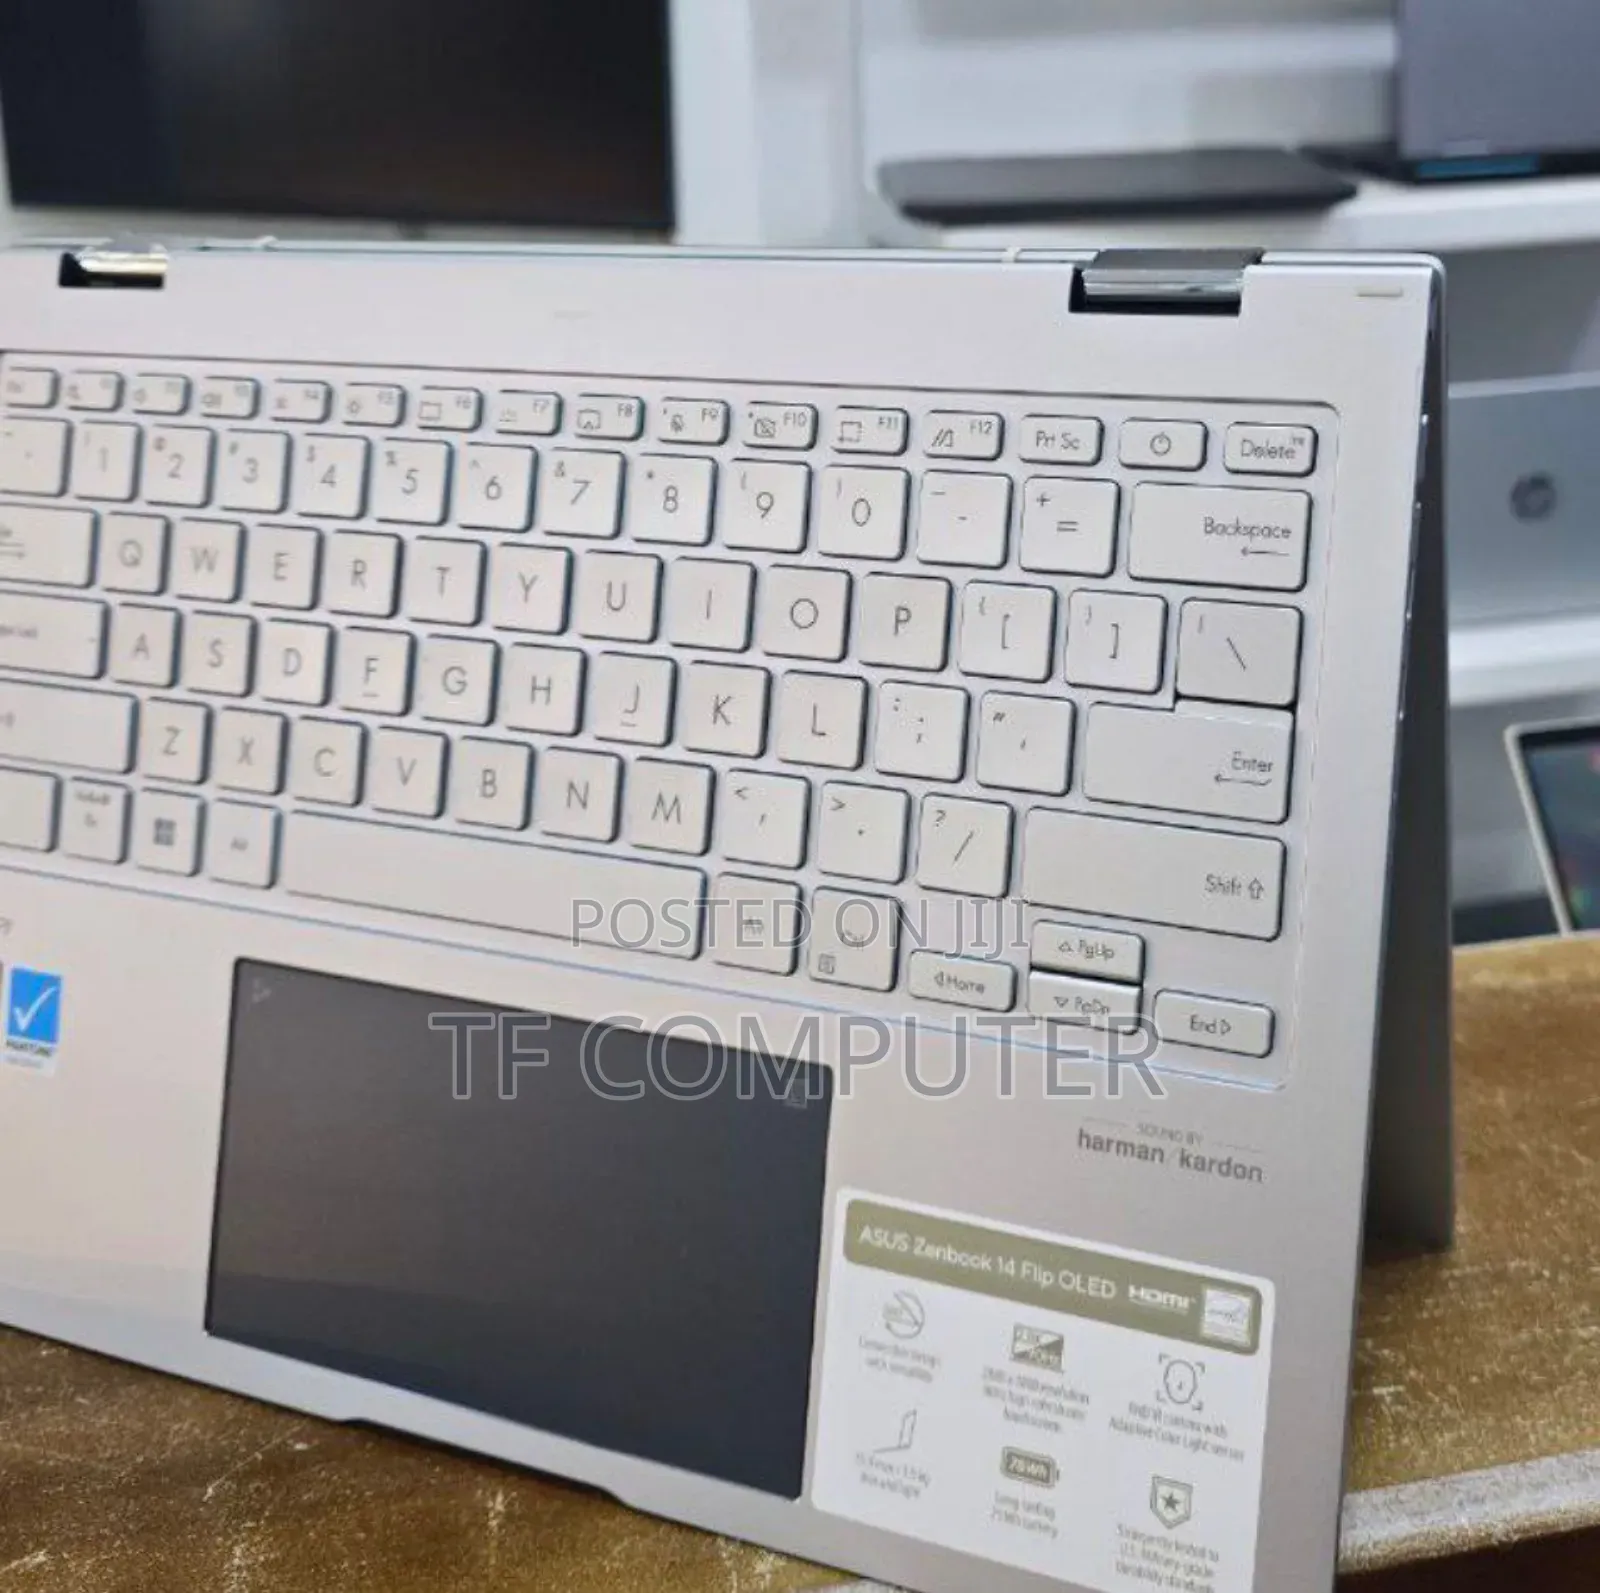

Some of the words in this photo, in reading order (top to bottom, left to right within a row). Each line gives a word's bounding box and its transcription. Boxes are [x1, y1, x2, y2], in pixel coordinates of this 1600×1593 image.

[617, 404, 633, 418] F8
[702, 408, 718, 423] F9
[969, 421, 993, 435] F12
[1240, 437, 1297, 459] Delete
[167, 453, 186, 480] 2
[242, 458, 260, 485] 3
[320, 463, 338, 489] 4
[401, 468, 420, 495] 5
[486, 475, 502, 501] 6
[570, 479, 591, 506] 7
[662, 484, 680, 514] 8
[755, 490, 774, 520] 9
[1203, 515, 1293, 543] Backspace
[117, 539, 145, 569] Q
[189, 546, 219, 574] W
[272, 552, 289, 582] E
[350, 558, 368, 590] R
[436, 565, 451, 596] T
[518, 571, 538, 604] Y
[605, 580, 628, 612] U
[893, 604, 913, 637] P
[132, 633, 151, 660] A
[207, 639, 225, 669] S
[281, 647, 303, 678] D
[364, 655, 380, 686] F
[441, 665, 469, 696] G
[530, 675, 553, 706] H
[622, 683, 640, 715] J
[711, 693, 733, 726] K
[810, 702, 828, 737] L
[161, 726, 183, 757] Z
[236, 736, 255, 767] X
[312, 747, 337, 778] C
[396, 756, 417, 787] V
[1230, 752, 1274, 774] Enter
[479, 767, 499, 800] B
[565, 780, 591, 811] N
[650, 791, 683, 826] M
[1204, 873, 1242, 897] Shift
[1076, 938, 1116, 961] PgUp
[946, 974, 986, 994] Home
[1189, 1017, 1218, 1034] End
[1077, 1126, 1165, 1164] harman
[1178, 1147, 1264, 1183] kardon
[858, 1224, 910, 1253] ASUS
[912, 1236, 993, 1273] Zenbook
[997, 1254, 1016, 1277] 14
[1020, 1260, 1055, 1289] Flip
[1057, 1269, 1118, 1299] OLED
